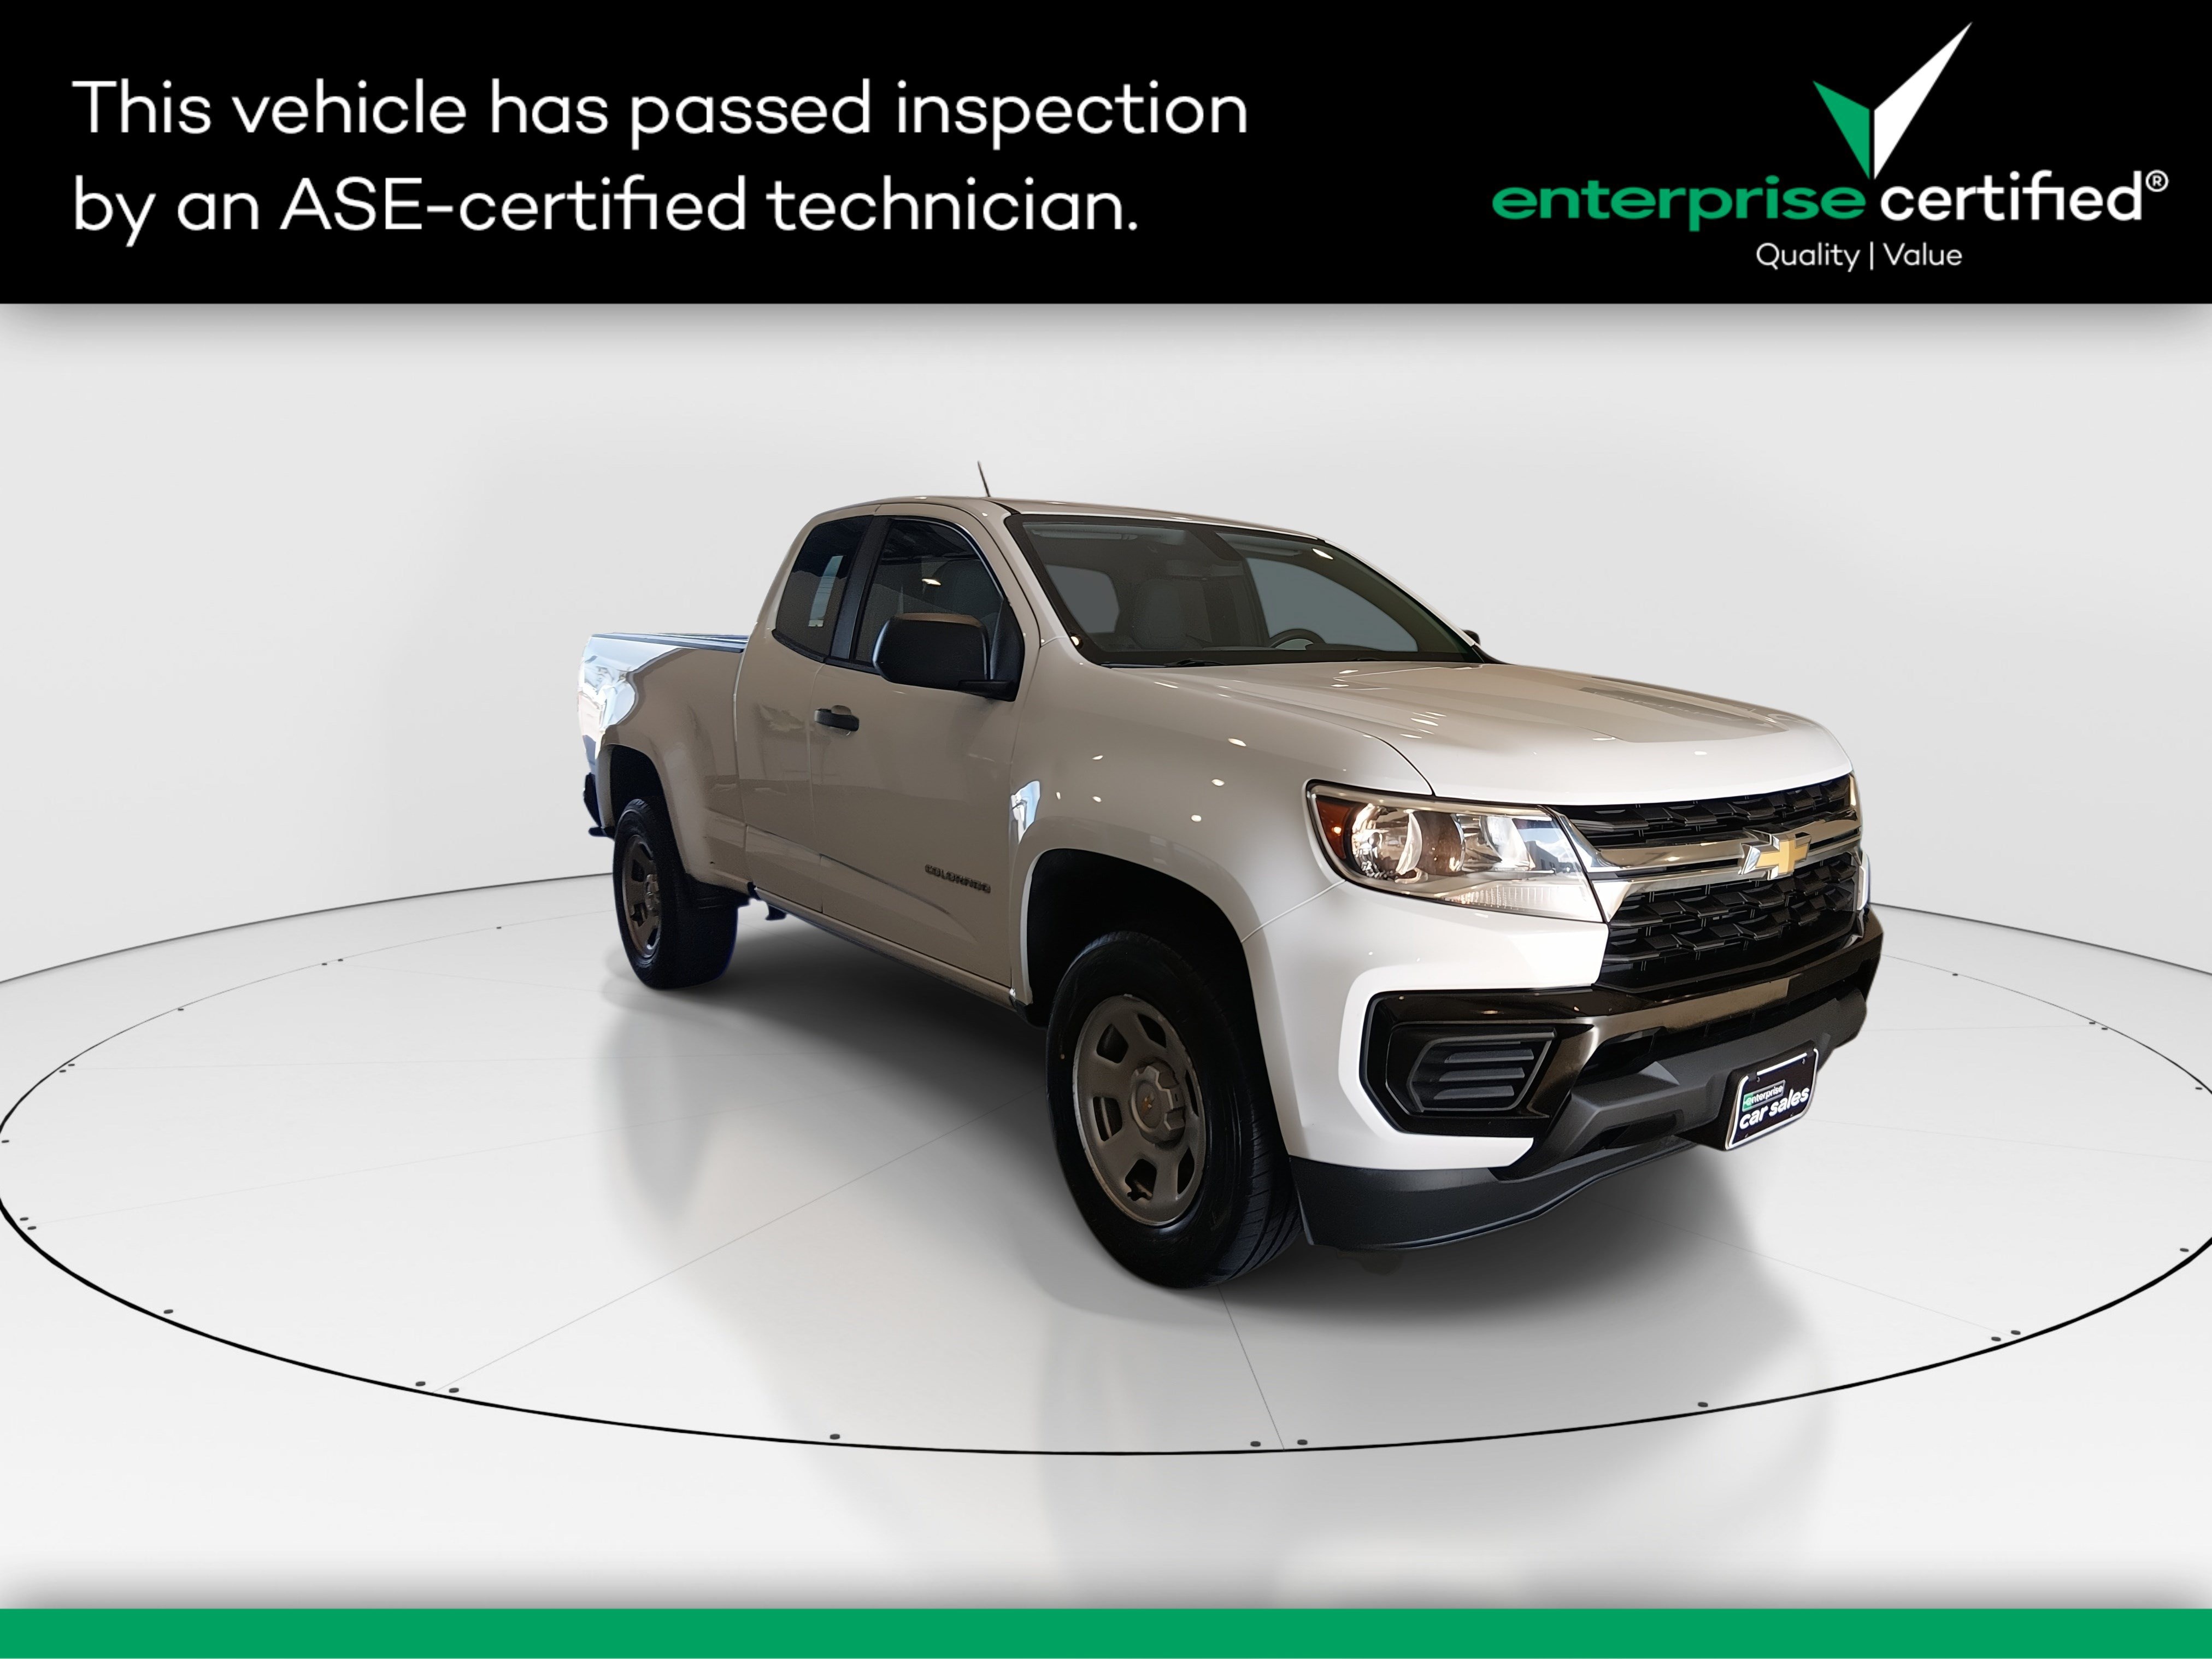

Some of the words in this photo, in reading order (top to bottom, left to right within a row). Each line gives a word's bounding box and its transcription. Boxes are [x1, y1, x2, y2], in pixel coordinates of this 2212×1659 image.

[1739, 1106, 1768, 1129] car
[1769, 1087, 1810, 1117] sales
[1745, 1085, 1784, 1106] enterprise
